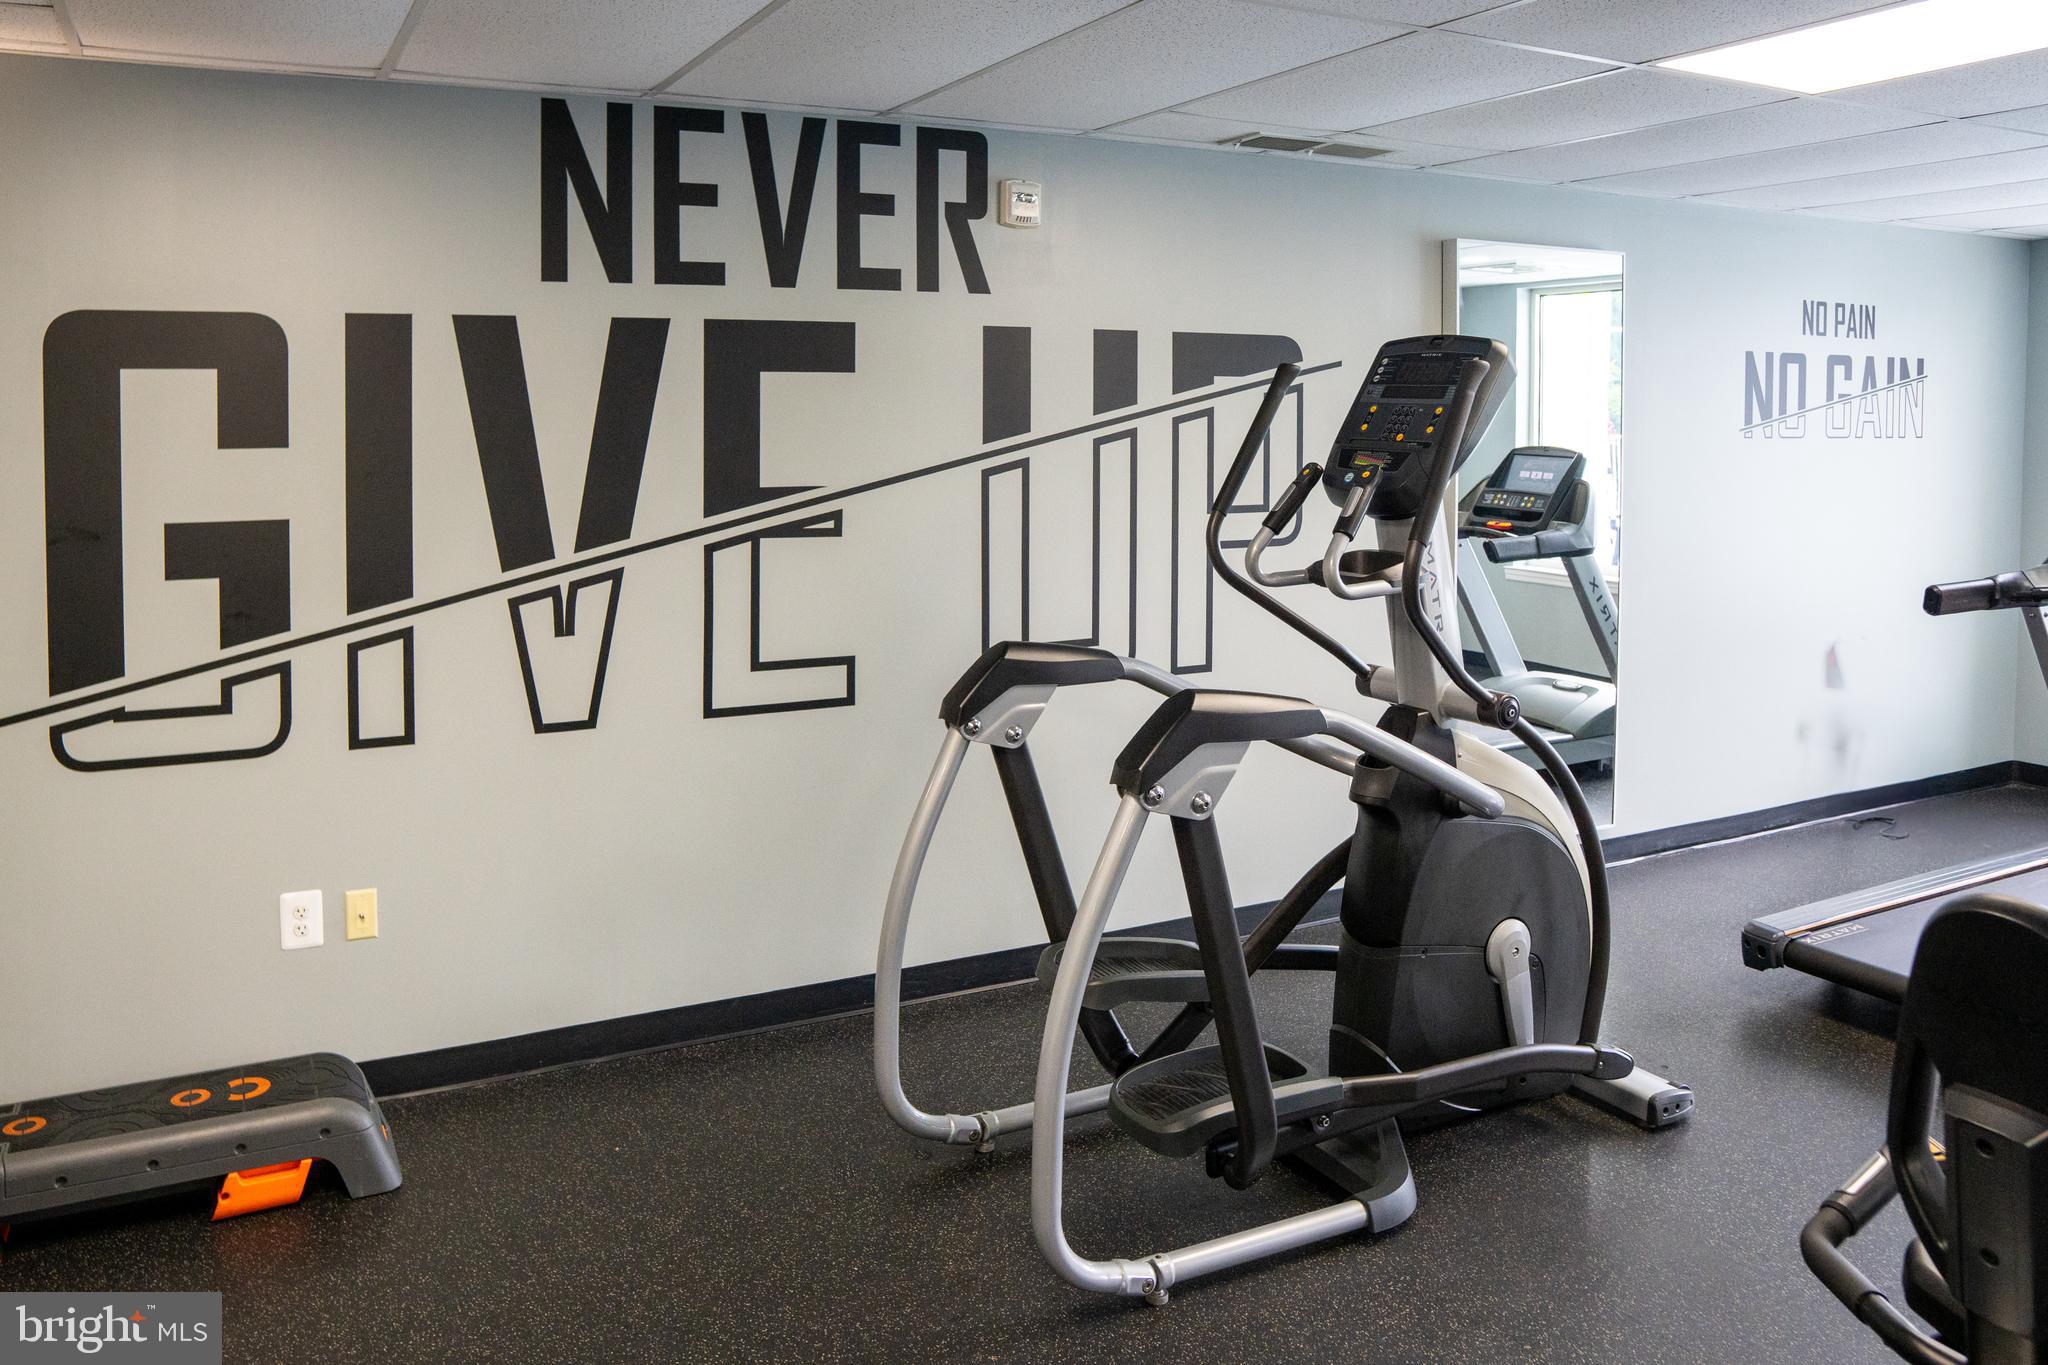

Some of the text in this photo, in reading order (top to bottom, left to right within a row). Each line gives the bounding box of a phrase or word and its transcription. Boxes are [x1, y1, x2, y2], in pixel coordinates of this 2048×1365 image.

[541, 97, 991, 294] NEVER
[1802, 299, 1876, 339] NO PAIN
[1744, 351, 1925, 438] NO GAIN
[43, 309, 1303, 772] GIVE UP
[1420, 541, 1444, 634] MATR
[1802, 924, 1865, 943] MATRIX
